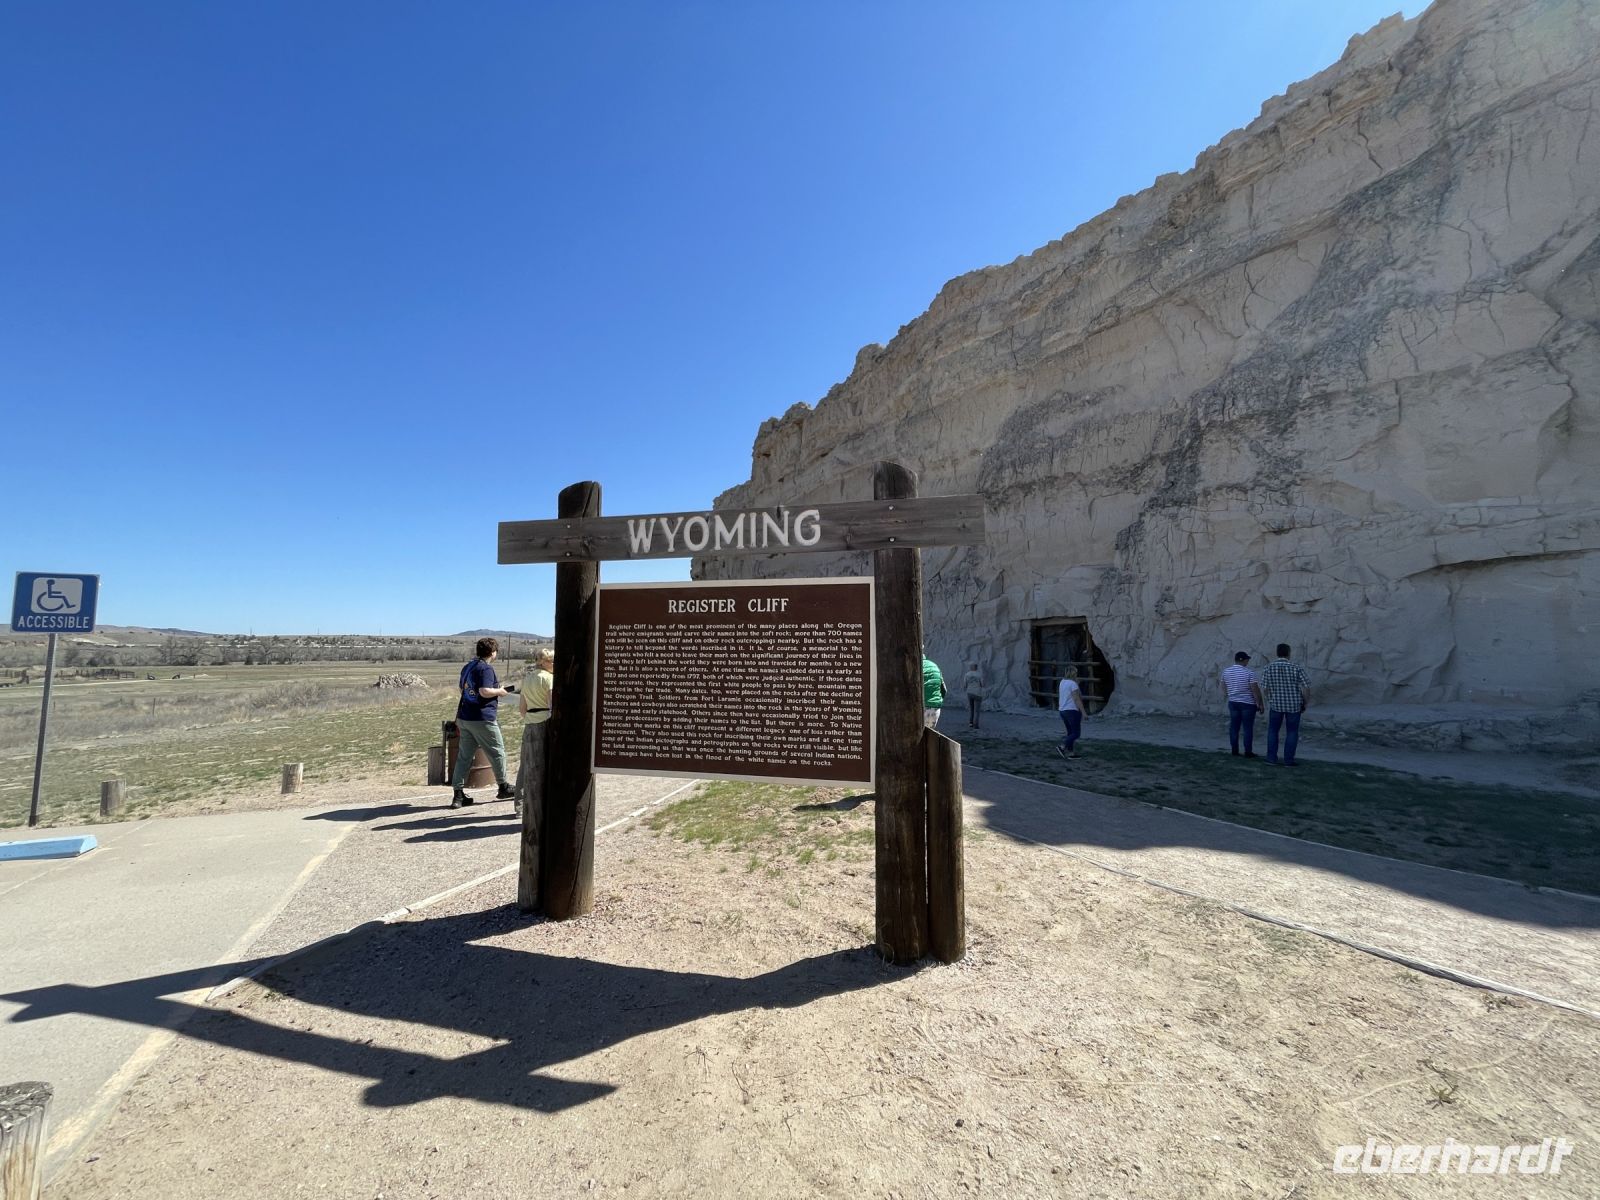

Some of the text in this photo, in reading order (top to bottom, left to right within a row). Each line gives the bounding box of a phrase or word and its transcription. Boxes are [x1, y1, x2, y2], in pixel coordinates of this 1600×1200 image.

[627, 509, 821, 553] WYOMING
[668, 598, 789, 613] REGISTER CLIFF
[17, 615, 90, 629] ACCESSIBLE
